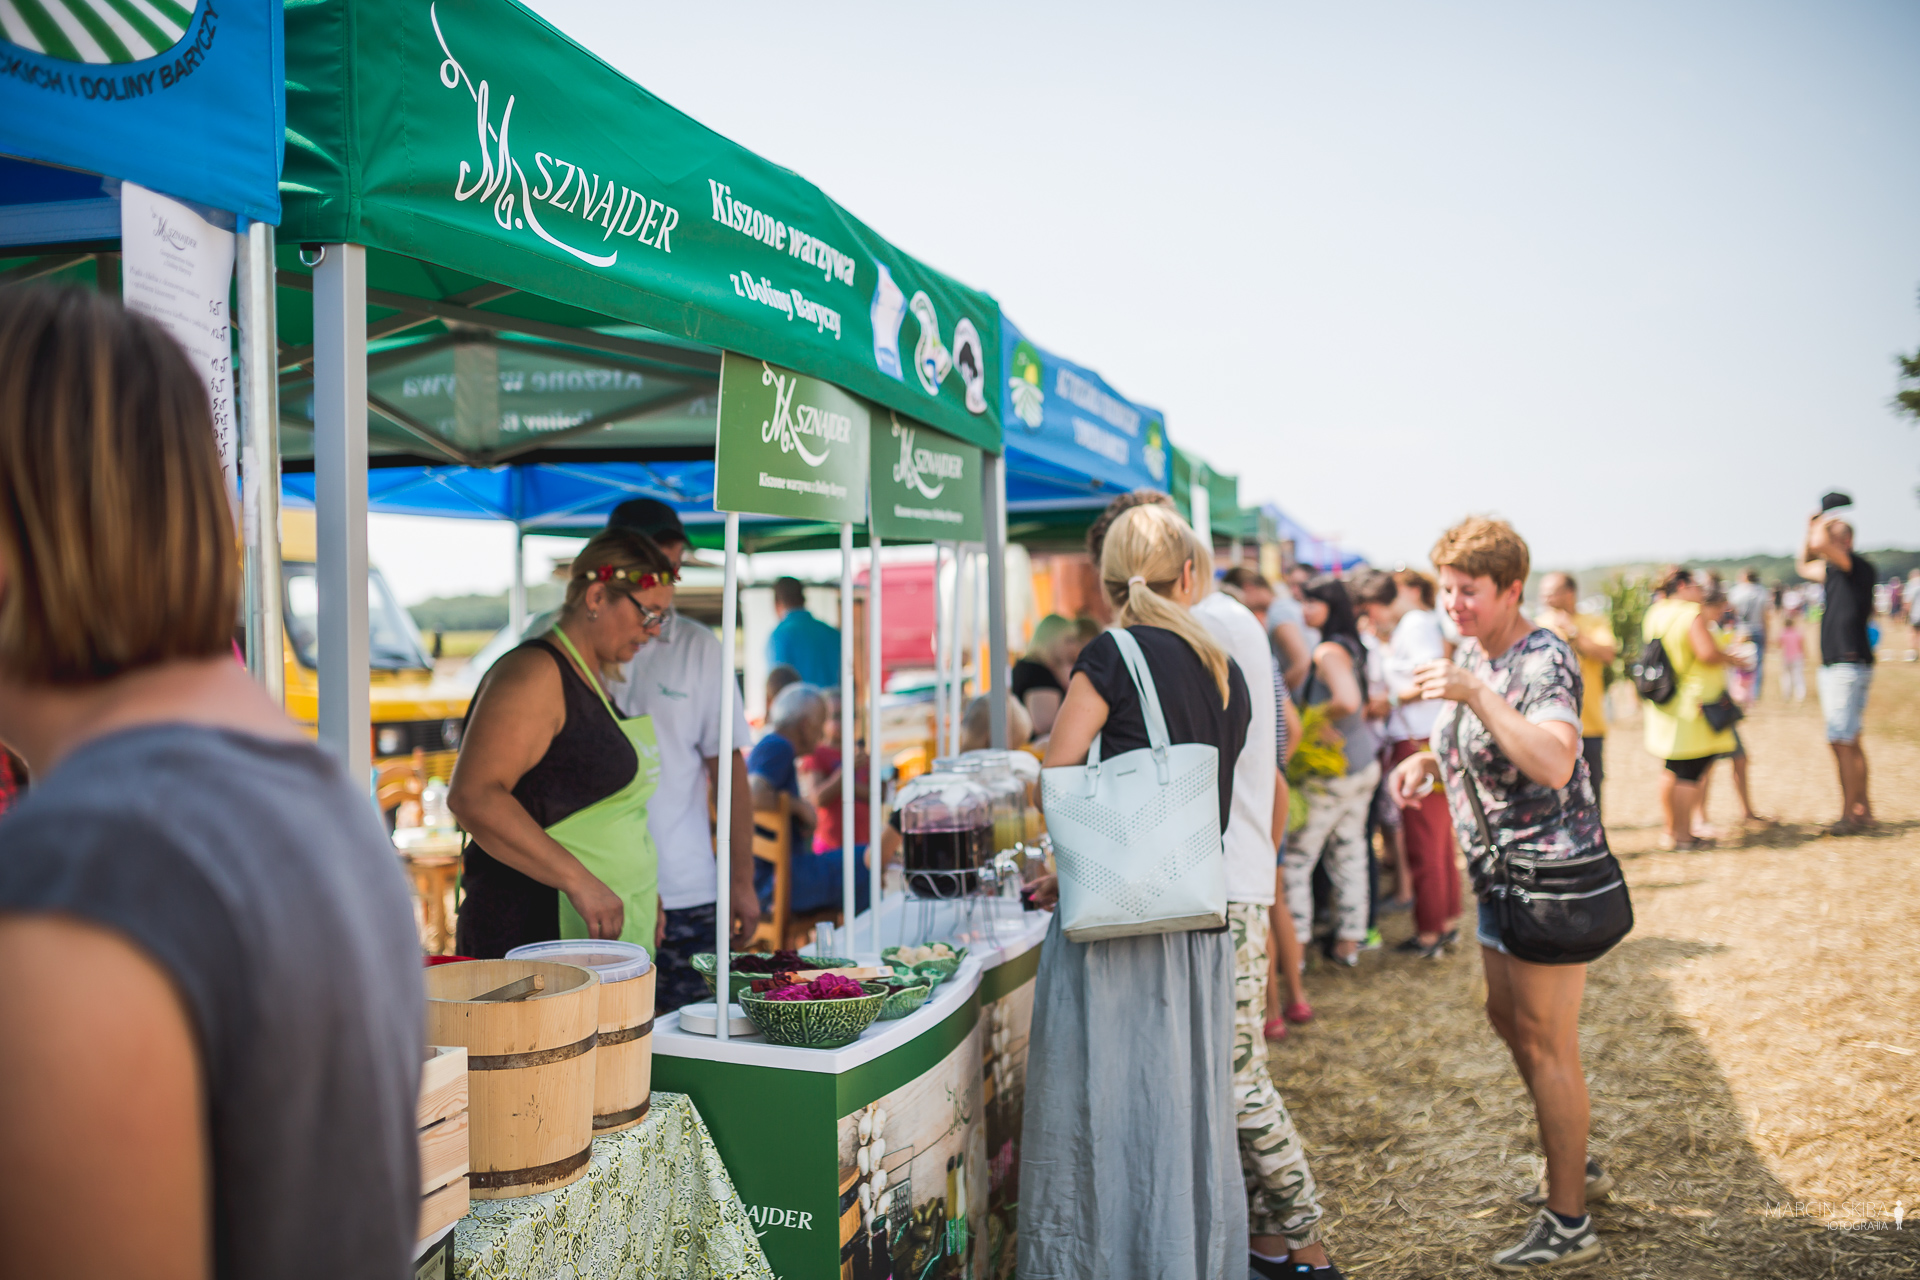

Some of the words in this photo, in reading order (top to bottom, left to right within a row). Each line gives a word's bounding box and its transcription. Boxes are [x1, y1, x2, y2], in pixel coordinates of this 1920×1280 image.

[79, 71, 155, 101] DOLINY
[158, 0, 219, 90] BARYCZY
[532, 151, 680, 253] SZNAJDER
[708, 178, 787, 251] Kiszone
[787, 226, 856, 287] warzywa
[729, 273, 746, 297] z
[740, 270, 794, 321] Doliny
[790, 288, 842, 341] Baryczy
[794, 404, 852, 446] SZNAJDER
